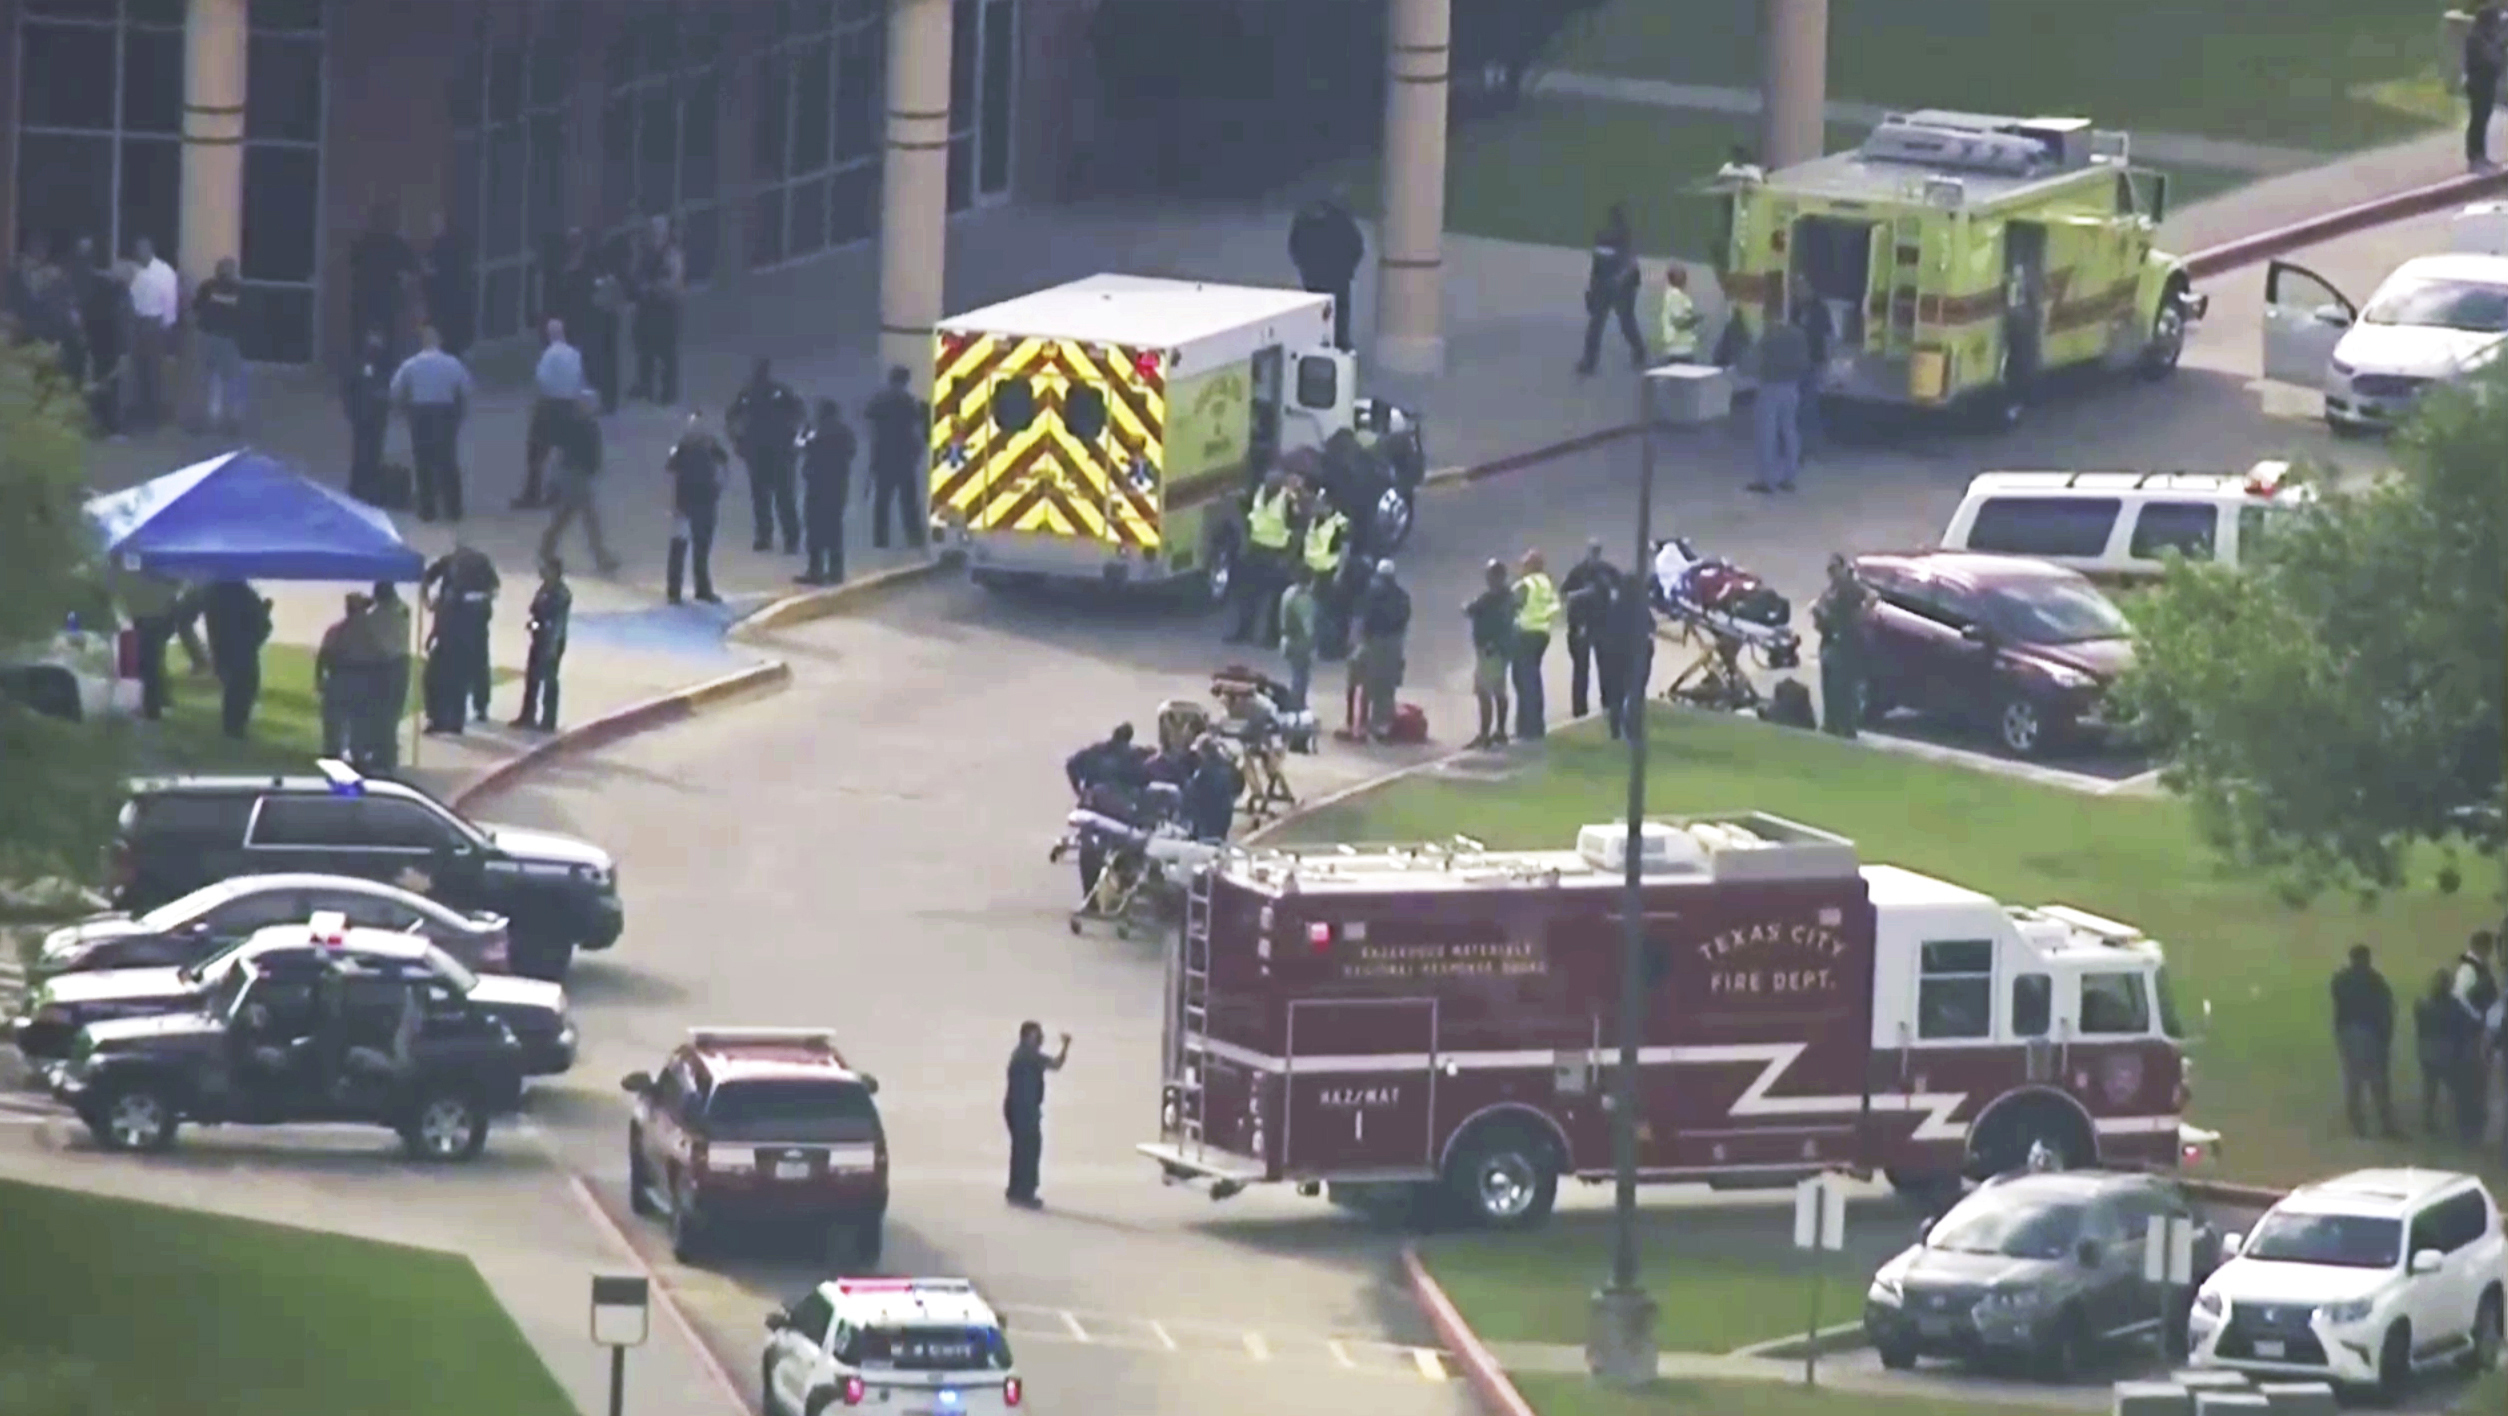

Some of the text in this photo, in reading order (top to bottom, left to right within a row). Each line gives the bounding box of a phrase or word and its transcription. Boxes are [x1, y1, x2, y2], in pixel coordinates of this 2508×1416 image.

[1700, 923, 1845, 961] TEXAS CITY
[1711, 968, 1837, 993] FIRE DEPT.
